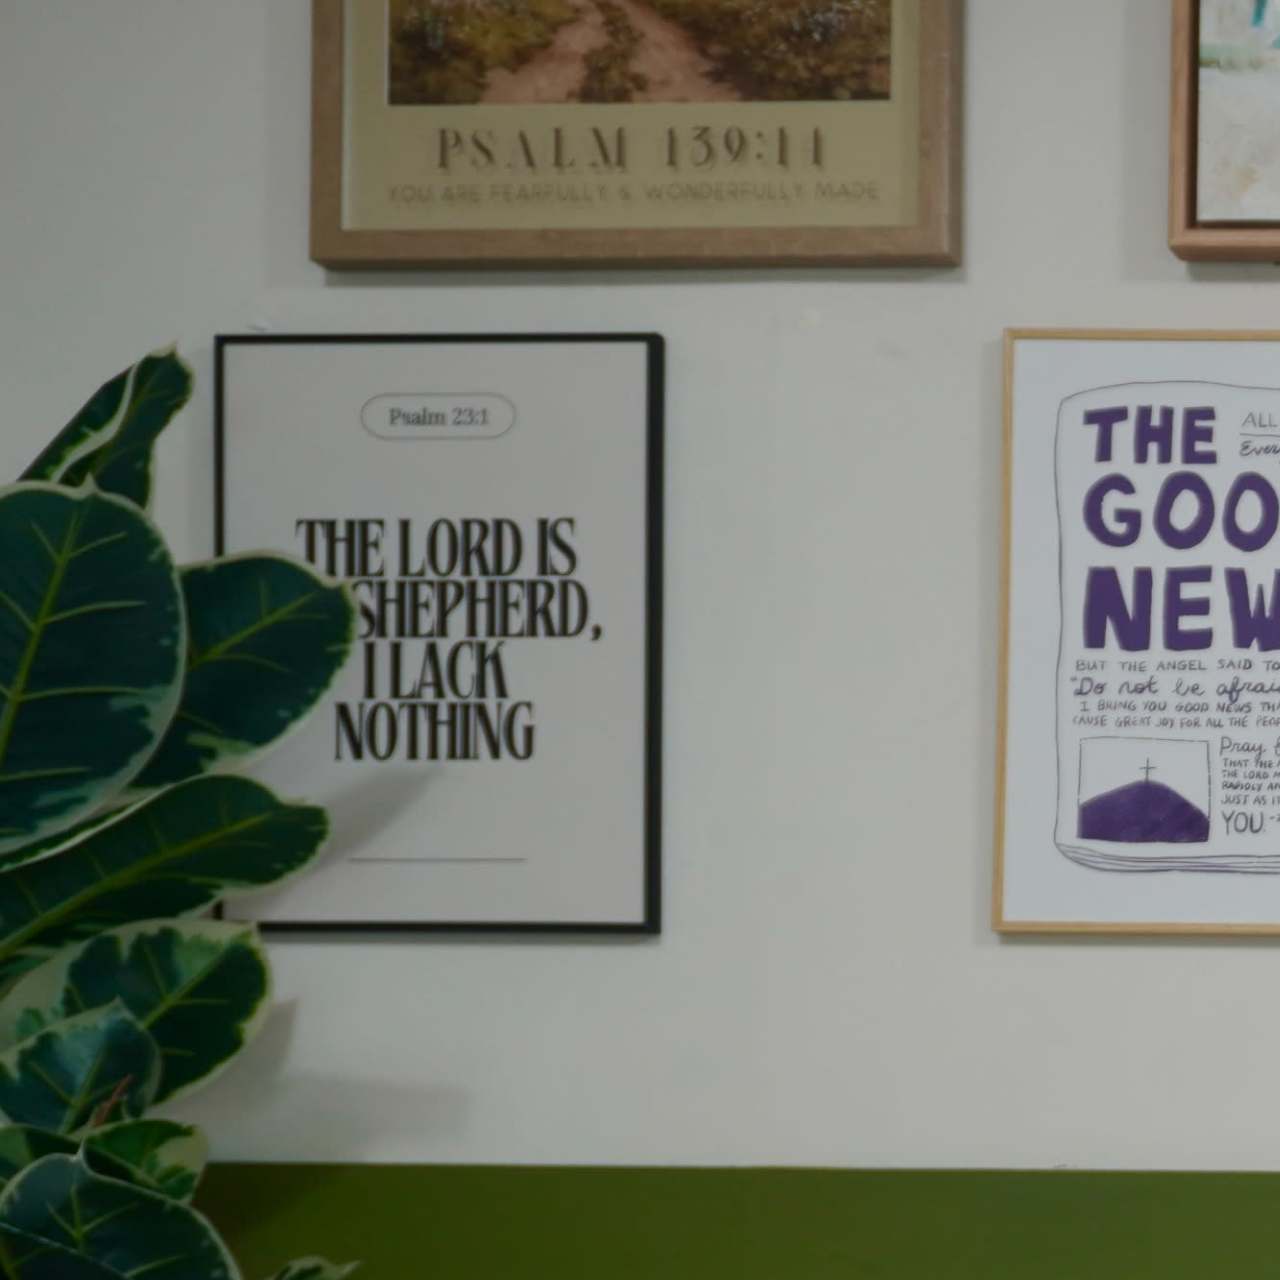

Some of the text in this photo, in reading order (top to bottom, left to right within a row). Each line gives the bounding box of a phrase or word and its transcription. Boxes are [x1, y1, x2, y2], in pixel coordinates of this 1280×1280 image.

[437, 126, 628, 169] PSALM
[441, 182, 480, 203] ARE
[489, 182, 605, 202] FEARFULLY
[646, 181, 802, 202] WONDERFULLY
[816, 180, 880, 200] MADE
[388, 405, 490, 427] Psalm 23:1
[1241, 411, 1278, 429] ALL
[1082, 404, 1218, 465] THE
[296, 517, 577, 579] THE LORD IS
[352, 579, 603, 643] SHEPHERD,
[363, 640, 510, 700] I LACK
[1075, 659, 1106, 672] BUT
[1120, 660, 1147, 672] THE
[1156, 660, 1208, 672] ANGEL
[1216, 659, 1253, 671] SAID
[1117, 677, 1159, 696] not
[1172, 677, 1205, 697] be
[1080, 700, 1090, 712] I
[1097, 700, 1137, 712] BRING
[1142, 701, 1167, 712] YOU
[1175, 702, 1210, 713] GOOD
[1216, 701, 1252, 714] NEWS
[334, 702, 535, 762] NOTHING
[1072, 715, 1108, 728] CAUSE
[1114, 715, 1152, 728] GREAT
[1154, 717, 1175, 729] JOY
[1179, 717, 1201, 729] FOR
[1205, 717, 1225, 729] ALL
[1228, 716, 1249, 728] THE
[1219, 735, 1266, 761] Pray
[1222, 757, 1250, 768] THAT
[1254, 758, 1274, 769] THE
[1222, 769, 1238, 779] THE
[1242, 770, 1270, 780] LORD
[1221, 794, 1250, 806] JUST
[1252, 795, 1268, 806] AS
